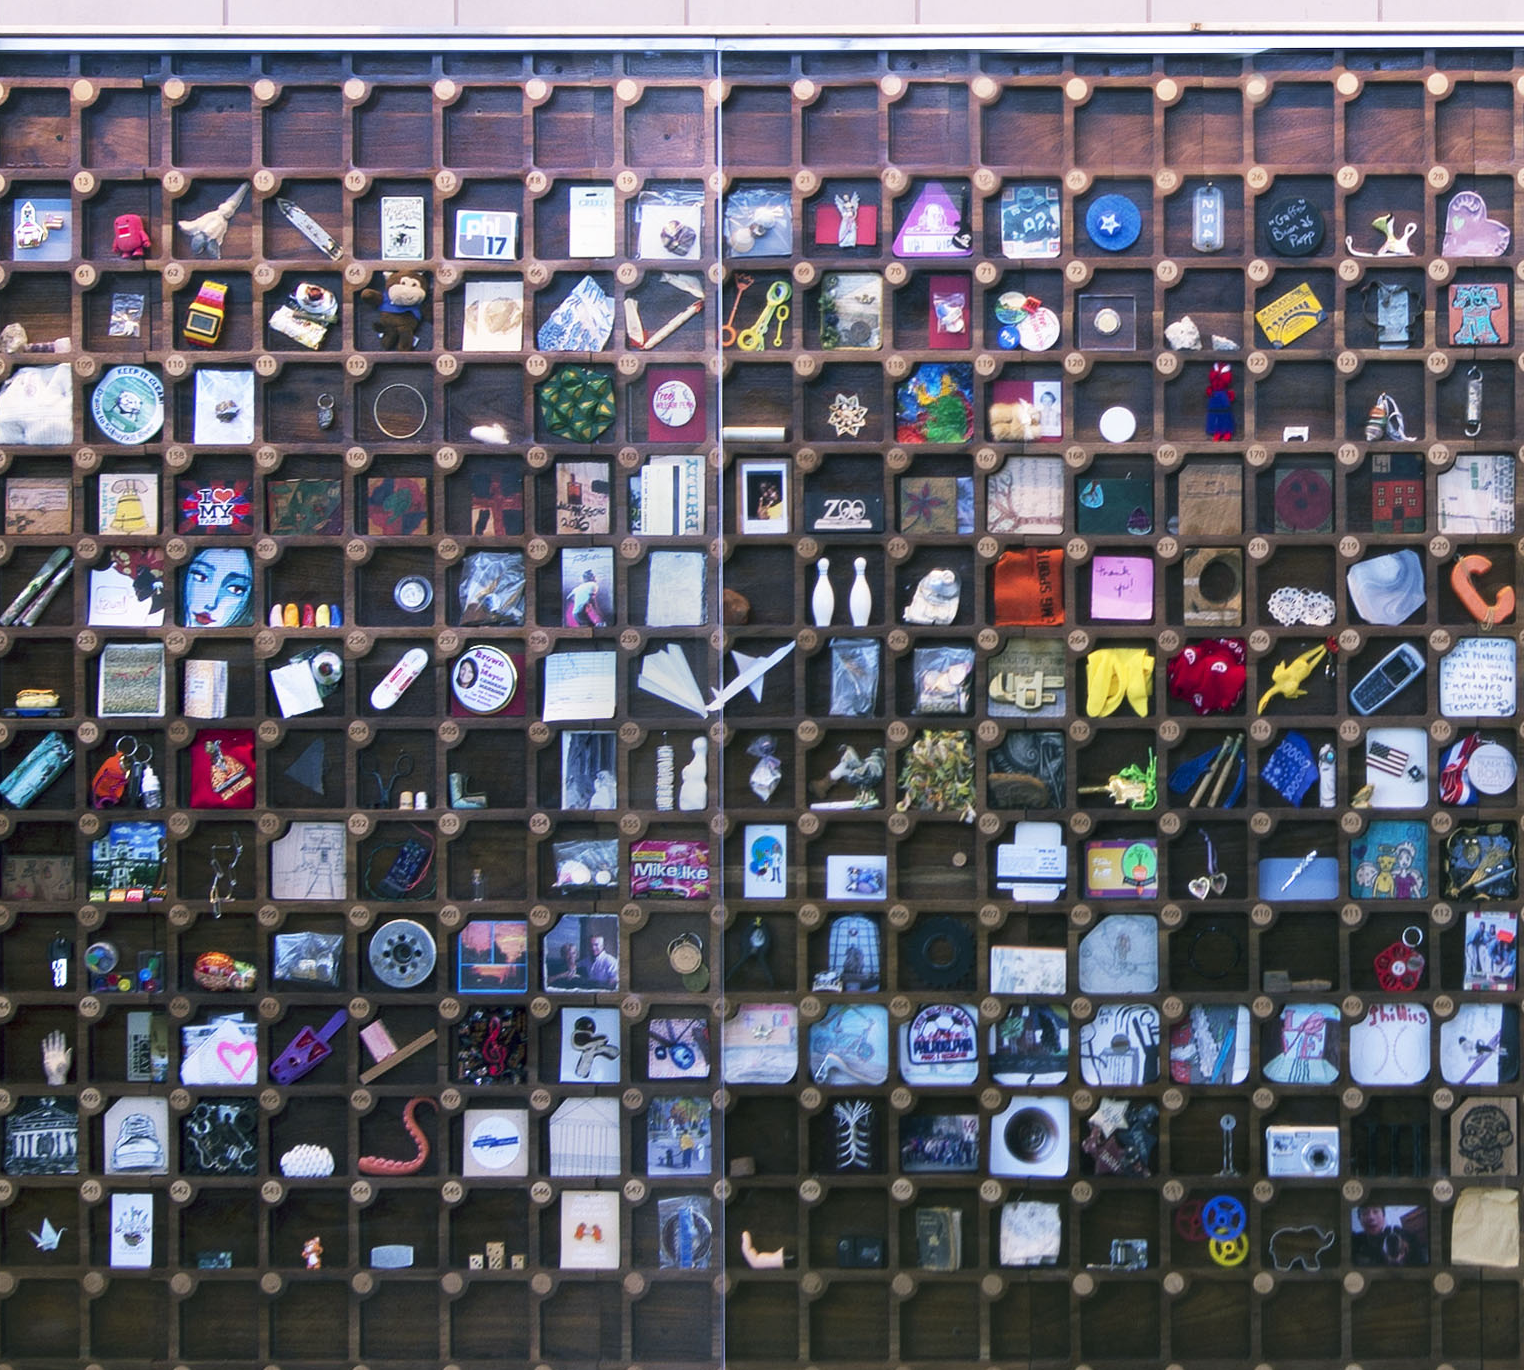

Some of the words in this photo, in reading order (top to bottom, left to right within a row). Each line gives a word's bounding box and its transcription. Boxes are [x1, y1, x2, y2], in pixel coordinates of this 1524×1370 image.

[168, 176, 179, 184] 14
[1342, 172, 1354, 181] 27
[1202, 198, 1214, 238] 254
[466, 214, 500, 240] phl
[486, 236, 507, 255] 17
[1067, 358, 1084, 368] 120
[1340, 449, 1356, 458] 171
[198, 490, 212, 503] I
[685, 459, 698, 530] PHILLY
[198, 504, 232, 519] MY
[823, 499, 866, 520] ZOO
[257, 543, 274, 553] 207
[1431, 541, 1449, 551] 220
[635, 862, 677, 877] Mike
[680, 866, 709, 880] Ike
